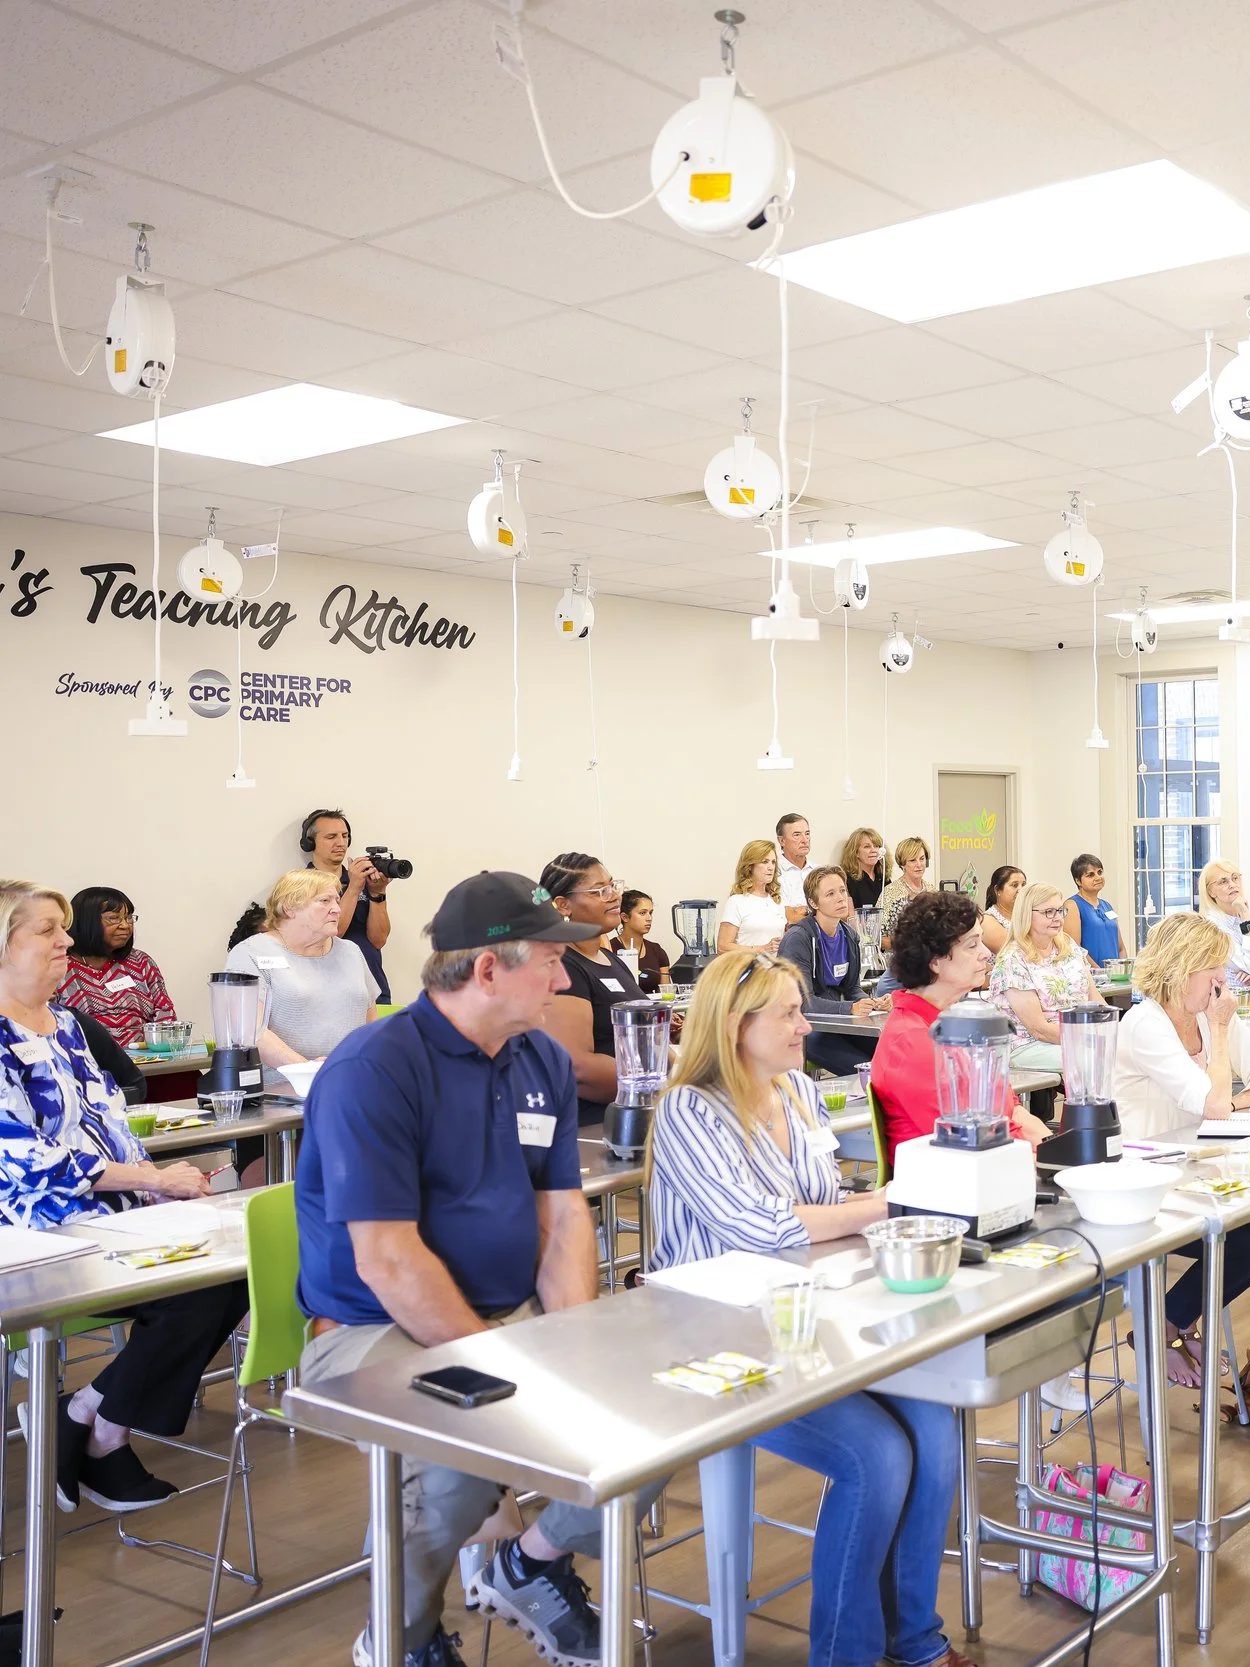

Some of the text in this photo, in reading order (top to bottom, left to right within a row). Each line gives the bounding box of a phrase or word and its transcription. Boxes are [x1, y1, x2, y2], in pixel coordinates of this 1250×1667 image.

[0, 548, 54, 618] 's
[319, 584, 476, 655] Kitchen
[55, 672, 142, 698] Sponsored
[240, 671, 352, 694] CENTER FOR
[189, 684, 231, 704] CPC
[241, 688, 323, 708] PRIMARY
[240, 705, 291, 723] CARE
[941, 817, 973, 833] Food
[941, 834, 995, 852] Farmacy
[487, 924, 511, 937] 2024
